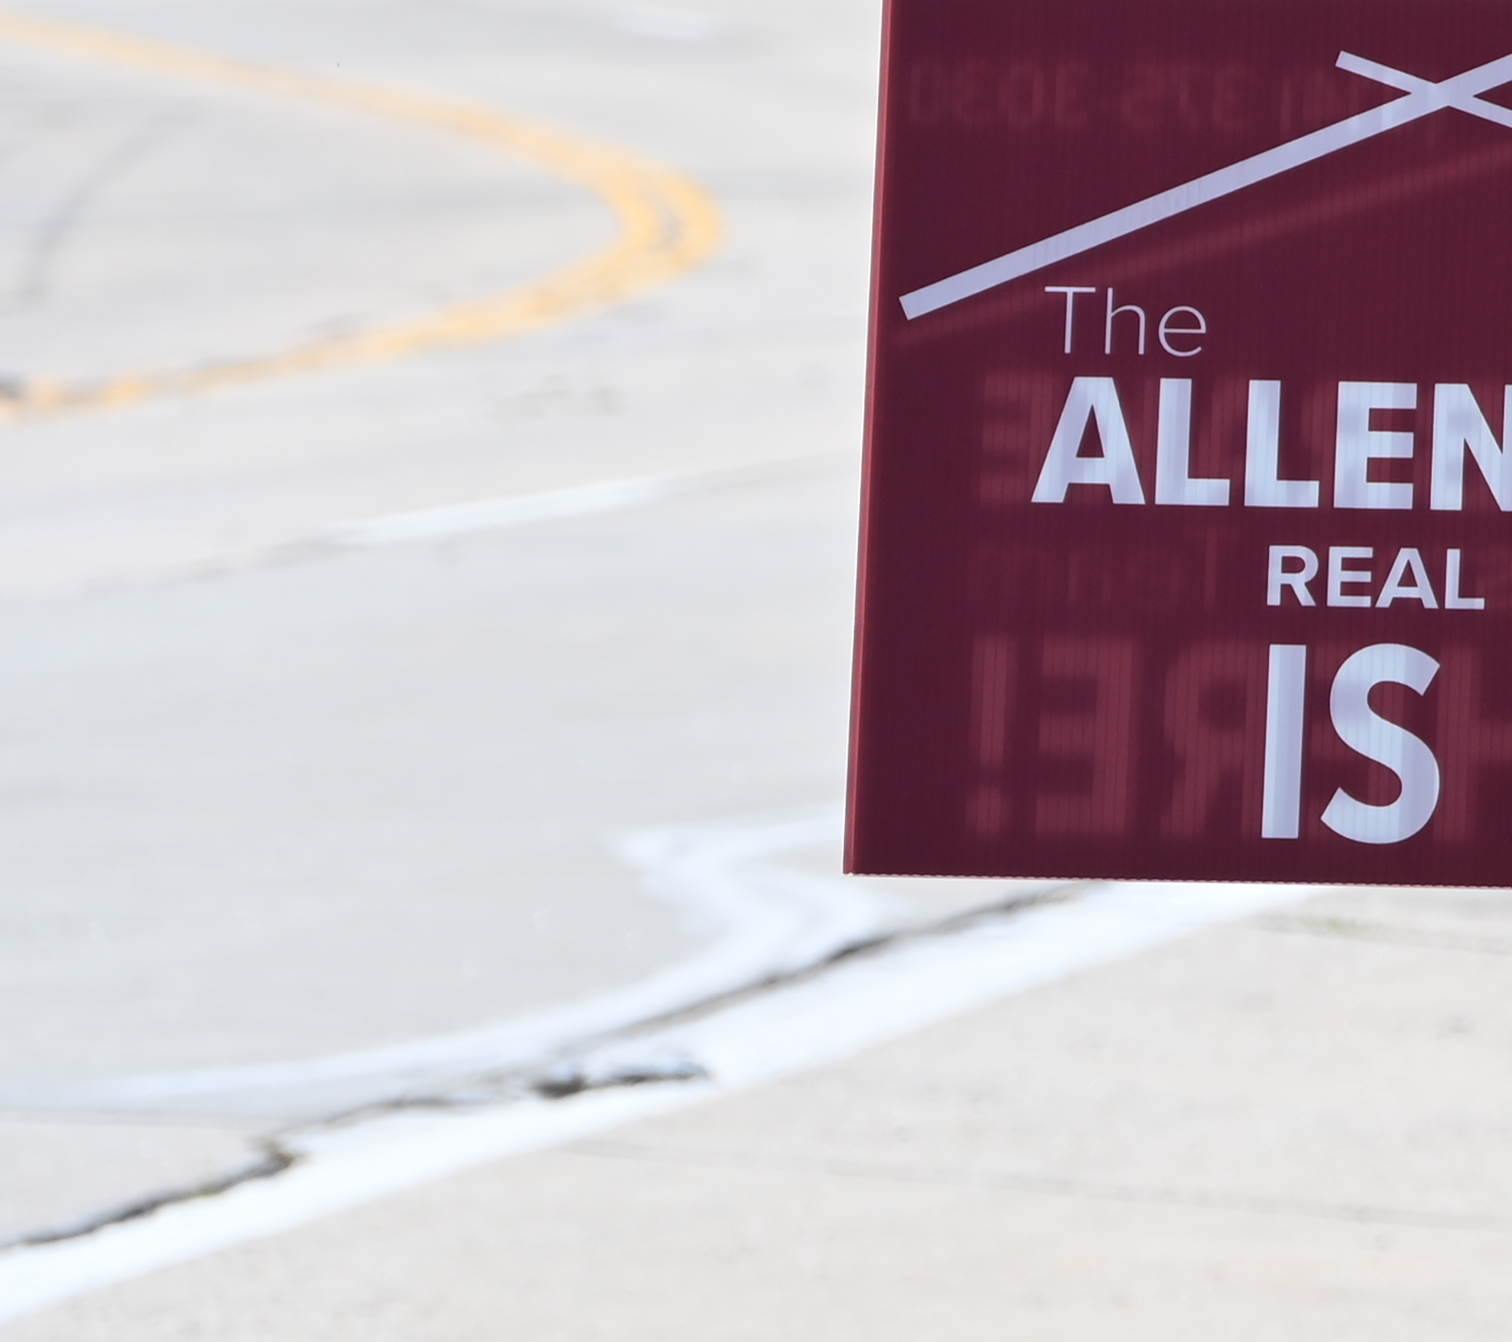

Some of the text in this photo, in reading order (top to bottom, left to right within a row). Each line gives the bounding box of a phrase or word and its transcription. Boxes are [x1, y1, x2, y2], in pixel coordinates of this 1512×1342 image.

[1044, 284, 1209, 360] The
[1266, 543, 1486, 611] REAL
[1261, 642, 1442, 846] IS
